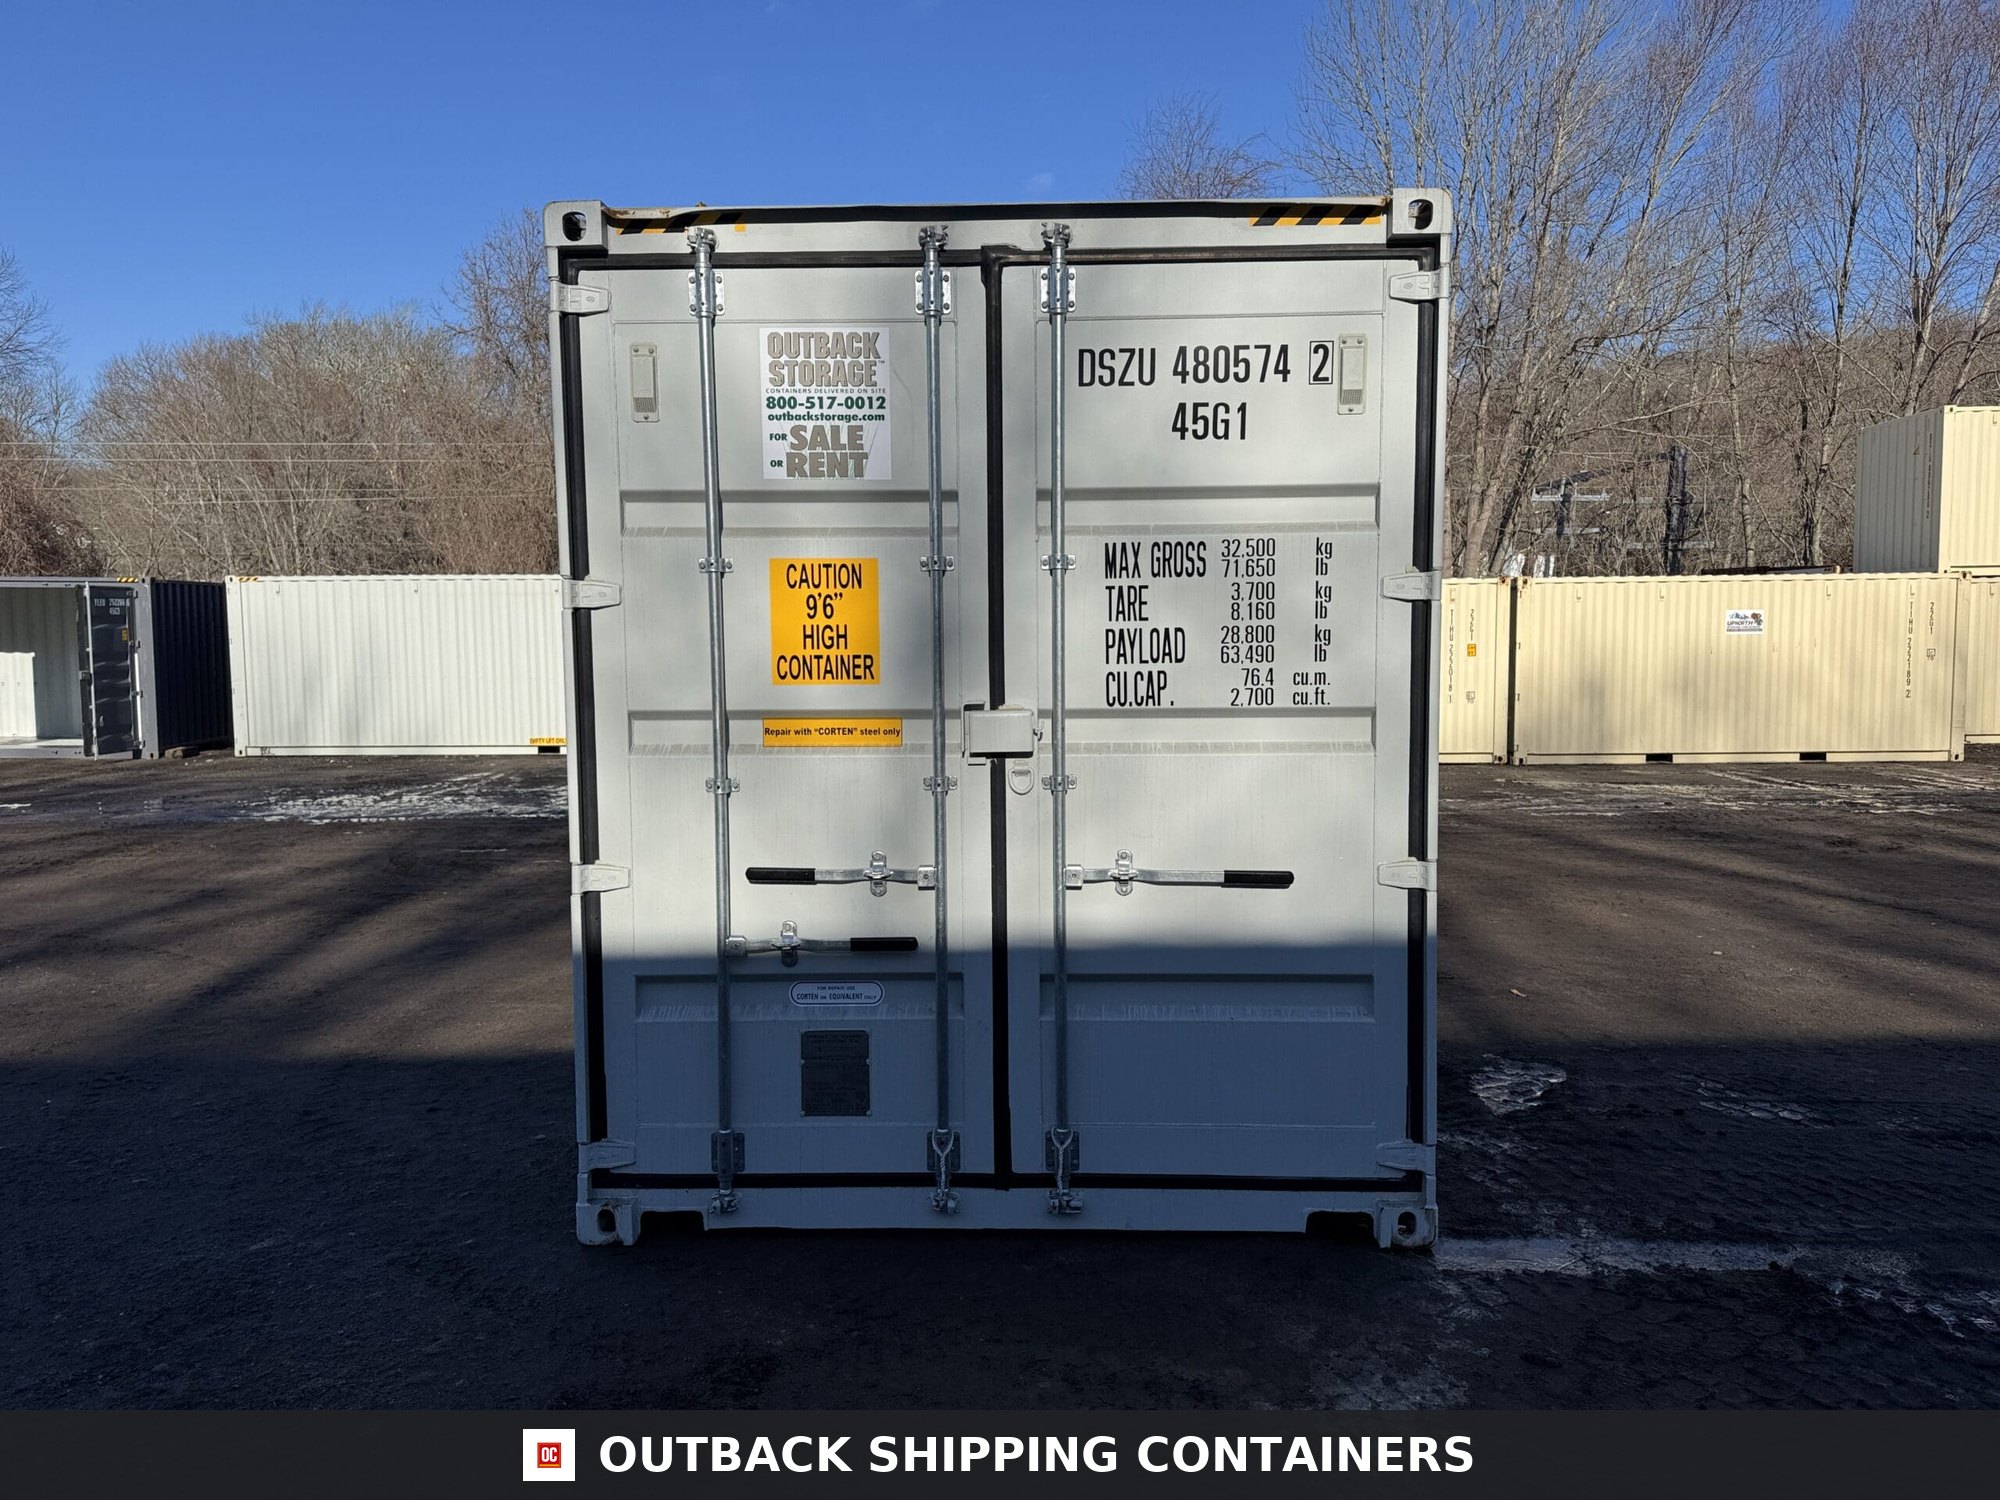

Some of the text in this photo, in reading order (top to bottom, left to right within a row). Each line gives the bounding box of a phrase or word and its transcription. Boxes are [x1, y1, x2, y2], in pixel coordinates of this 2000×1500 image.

[767, 332, 881, 359] OUTBACK
[768, 360, 878, 387] STORAGE
[1078, 344, 1330, 387] DSZU 480574 2
[766, 396, 886, 409] 800-517-0012
[768, 411, 885, 423] outbackstorage.com
[1172, 402, 1247, 440] 45G1
[770, 424, 864, 451] FOR SALE
[786, 452, 869, 478] RENT
[1104, 537, 1333, 579] MAX GROSS 32,500 kg
[1222, 557, 1328, 578] 71,650 lb
[786, 563, 862, 589] CAUTION
[1105, 581, 1332, 622] TARE 3,700 kg
[1231, 601, 1327, 621] 8,160 lb
[802, 624, 848, 650] HIGH
[1105, 624, 1331, 665] PAYLOAD 28,800 kg
[777, 655, 874, 680] CONTAINER
[1220, 644, 1327, 665] 63,490 lb
[1241, 668, 1274, 686] 76.4
[1293, 671, 1331, 686] cu.m.
[1231, 688, 1330, 707] 2,700 cu.ft.
[765, 728, 791, 736] Repair
[860, 727, 880, 735] steel
[883, 727, 901, 737] only
